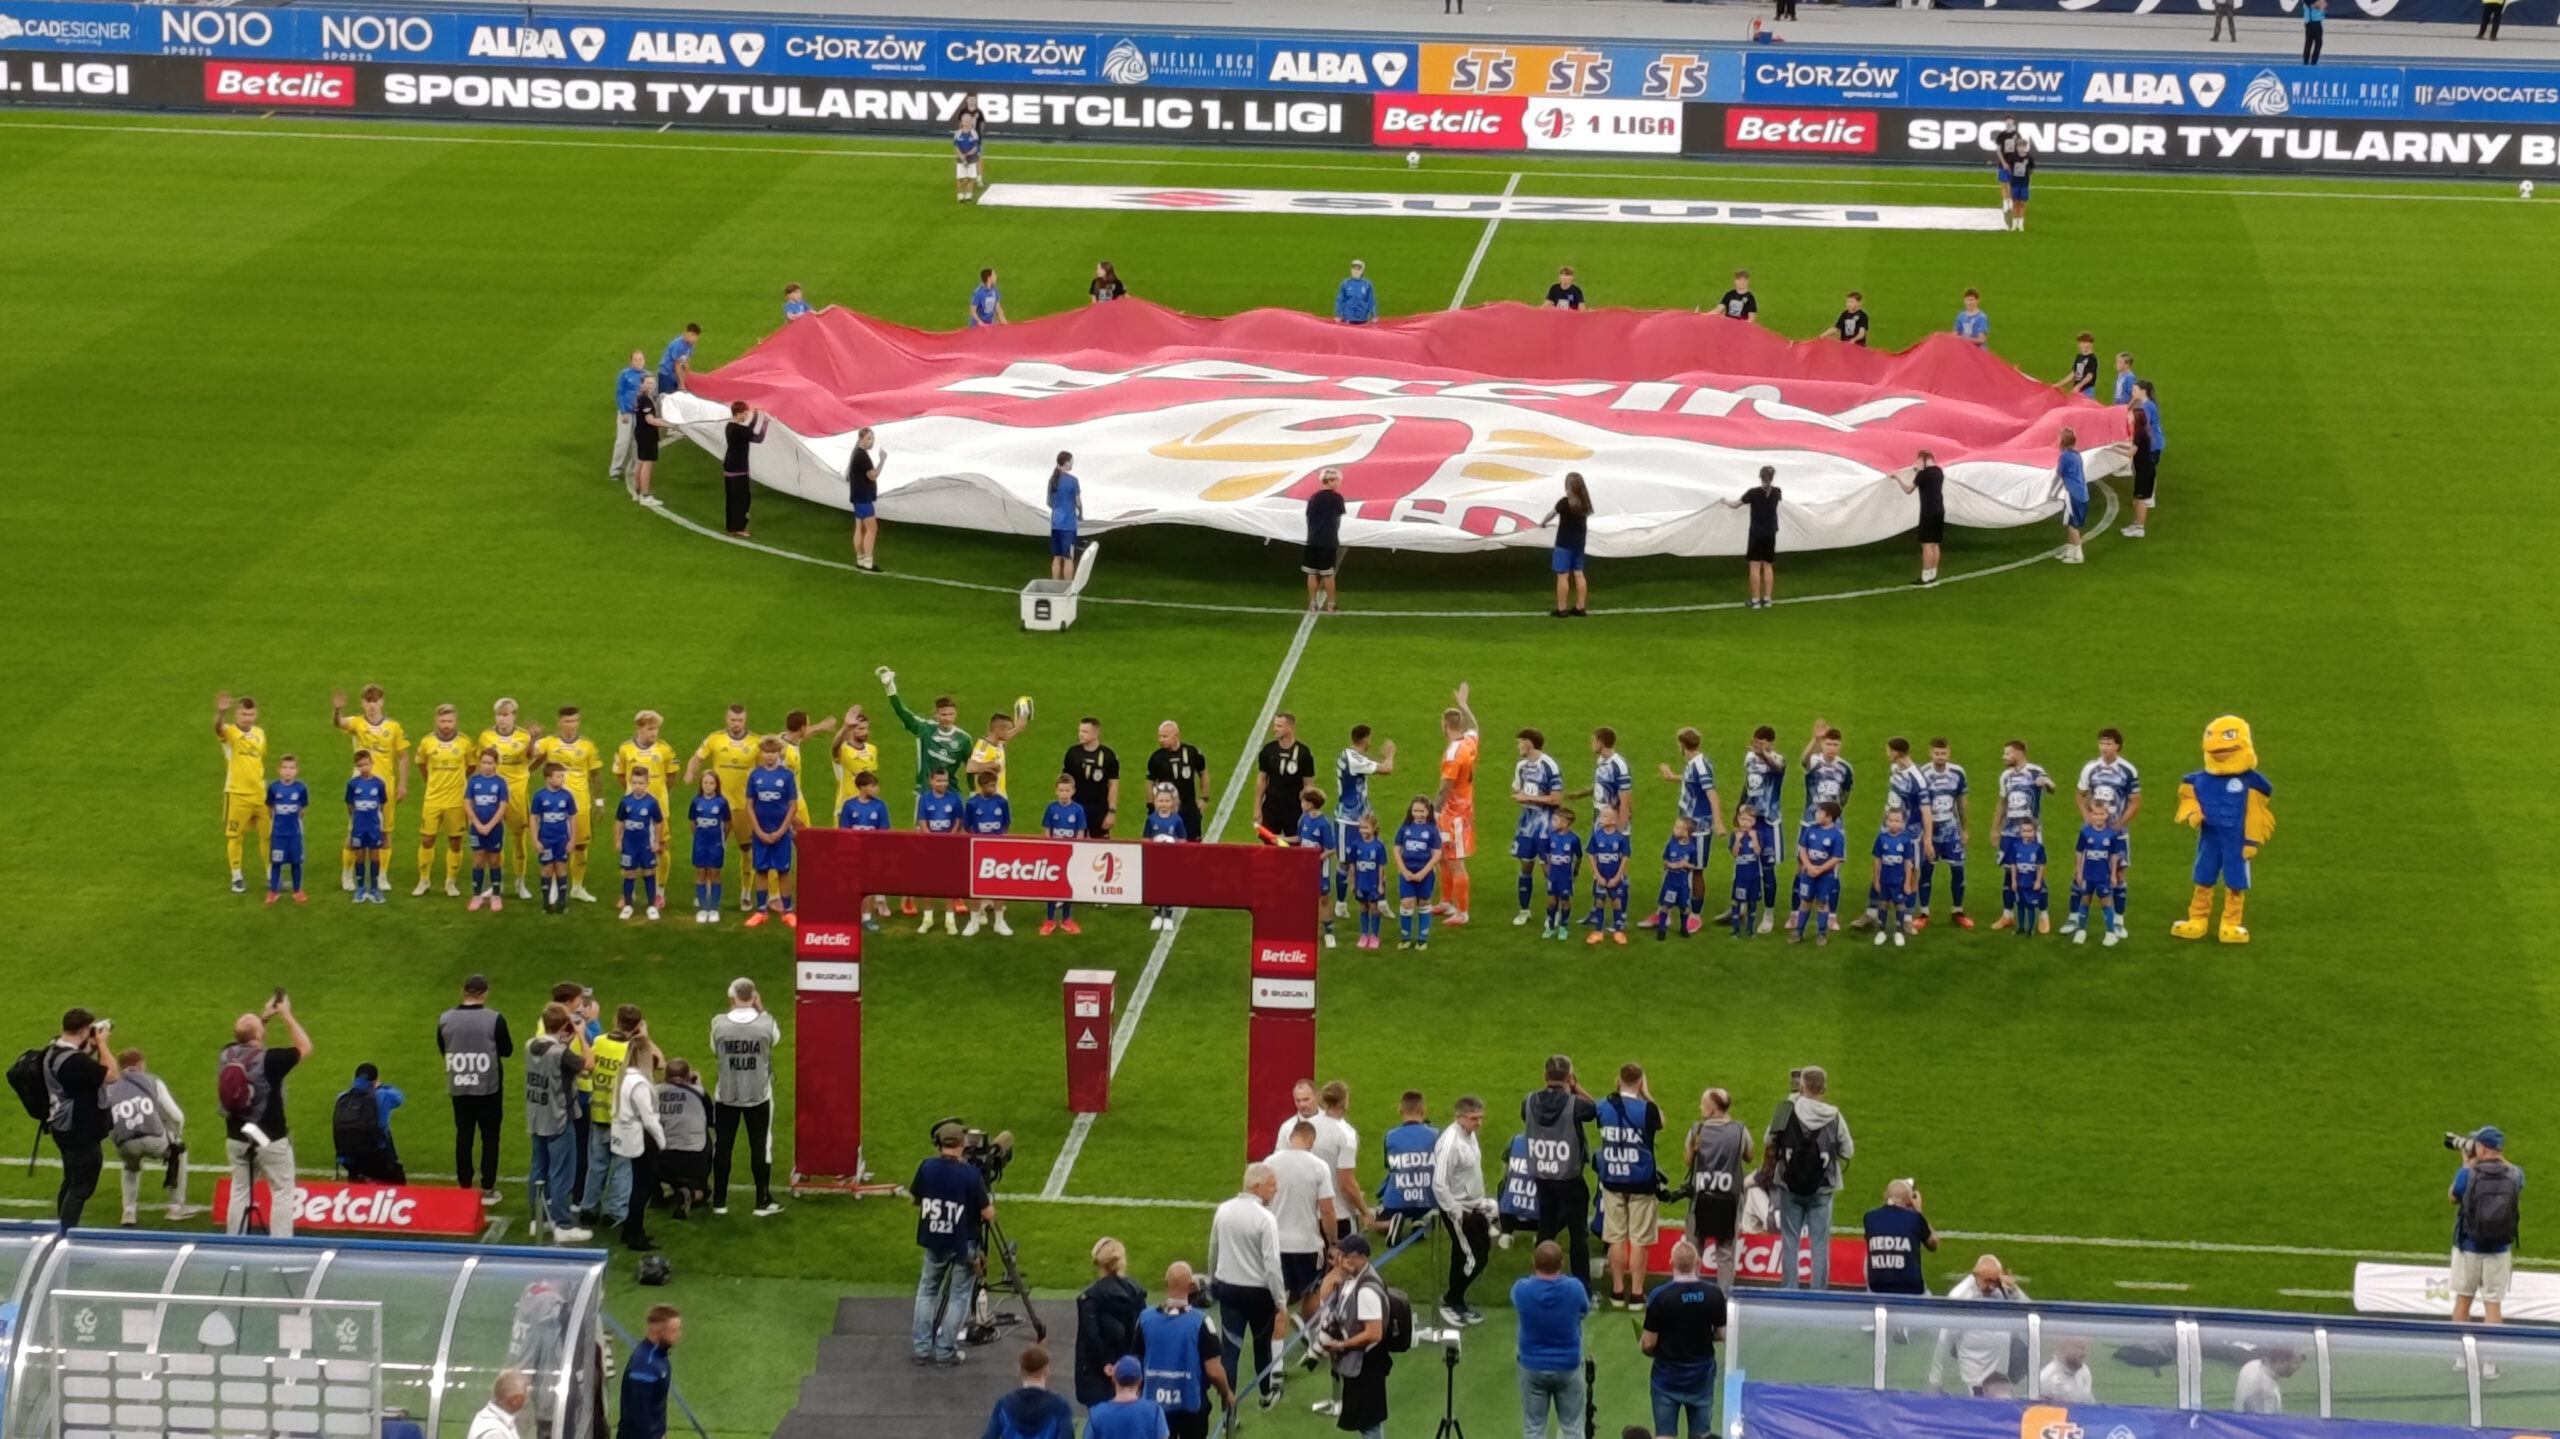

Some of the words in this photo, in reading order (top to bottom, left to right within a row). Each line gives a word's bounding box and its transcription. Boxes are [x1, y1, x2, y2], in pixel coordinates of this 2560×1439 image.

[25, 19, 130, 39] CADESIGNER
[161, 10, 273, 46] NO10
[322, 16, 433, 52] NO10
[162, 46, 213, 56] SPORTS
[468, 26, 567, 59] ALBA
[627, 32, 726, 64] ALBA
[322, 52, 373, 62] SPORTS
[1149, 52, 1204, 68] WIELKI
[1216, 53, 1254, 69] RUCH
[1269, 51, 1368, 84] ALBA
[31, 62, 129, 94] LIGI
[1450, 48, 1517, 95] STS
[1545, 51, 1612, 97] STS
[1642, 54, 1709, 99] STS
[216, 69, 343, 99] Betclic
[2082, 72, 2185, 105] ALBA
[2291, 81, 2348, 98] WIELKI
[2359, 83, 2400, 99] RUCH
[2437, 85, 2559, 103] AIDVOCATES
[385, 73, 637, 111] SPONSOR
[646, 82, 968, 122] TYTULARNY
[976, 93, 1193, 128] BETCLIC
[1201, 100, 1234, 130] 1.
[1244, 101, 1342, 133] LIGI
[1382, 107, 1502, 135] Betclic
[1587, 115, 1600, 134] 1
[1613, 116, 1675, 136] LIGA
[1736, 116, 1866, 145] Betclic
[2177, 126, 2512, 165] TYTULARNY
[1290, 197, 1880, 222] SUZUKI
[978, 857, 1061, 881] Betclic
[804, 932, 851, 946] Betclic
[1261, 949, 1308, 964] Betclic
[724, 1040, 761, 1054] MEDIA
[445, 1052, 491, 1073] FOTO
[729, 1056, 757, 1071] KLUB
[1388, 1152, 1436, 1170] MEDIA
[1527, 1138, 1570, 1161] FOTO
[1395, 1172, 1431, 1189] KLUB
[1508, 1178, 1538, 1197] KLU
[921, 1197, 943, 1220] PS
[944, 1200, 965, 1226] TV
[929, 1220, 954, 1234] 022
[1156, 1388, 1182, 1404] 012
